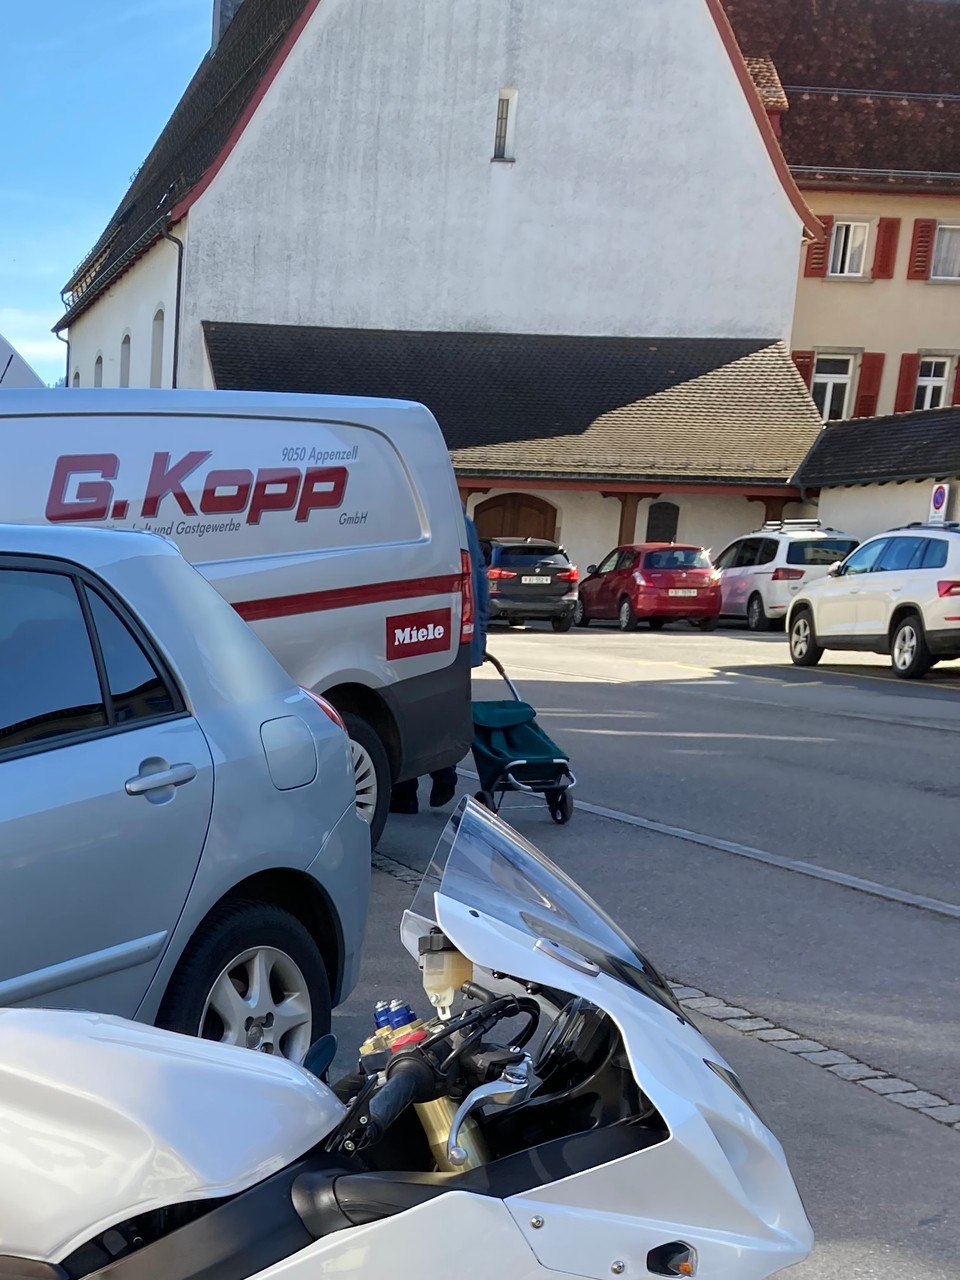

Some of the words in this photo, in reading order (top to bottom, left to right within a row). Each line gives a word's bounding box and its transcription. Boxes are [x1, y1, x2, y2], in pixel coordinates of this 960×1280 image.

[281, 447, 306, 462] 9050
[308, 445, 359, 465] Appenzell
[175, 517, 242, 537] Gastgewerbe
[338, 511, 368, 526] GmbH
[394, 623, 444, 646] Miele
